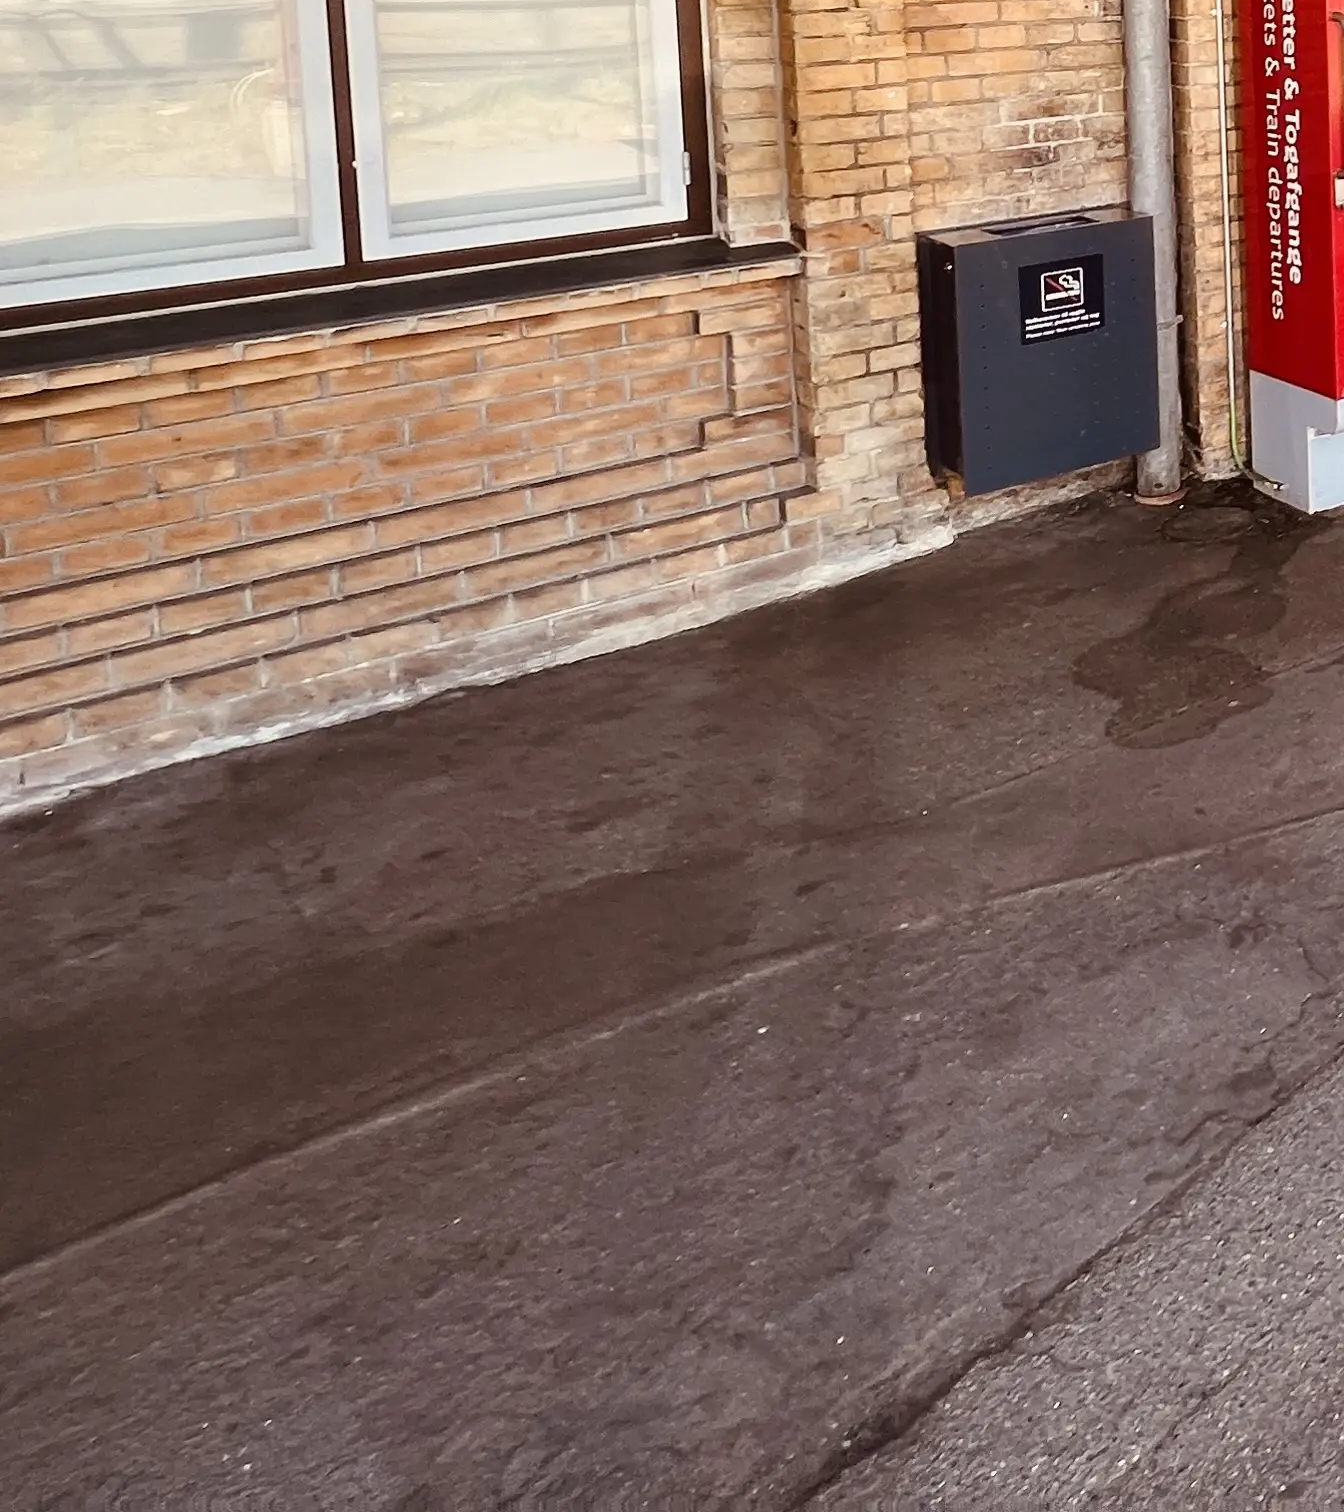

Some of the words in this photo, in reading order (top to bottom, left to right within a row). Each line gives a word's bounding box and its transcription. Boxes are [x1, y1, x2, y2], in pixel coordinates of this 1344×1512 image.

[1264, 56, 1280, 77] &
[1284, 77, 1300, 101] &
[1265, 88, 1282, 157] Train
[1283, 108, 1303, 285] Togafgange
[1266, 166, 1284, 320] departures
